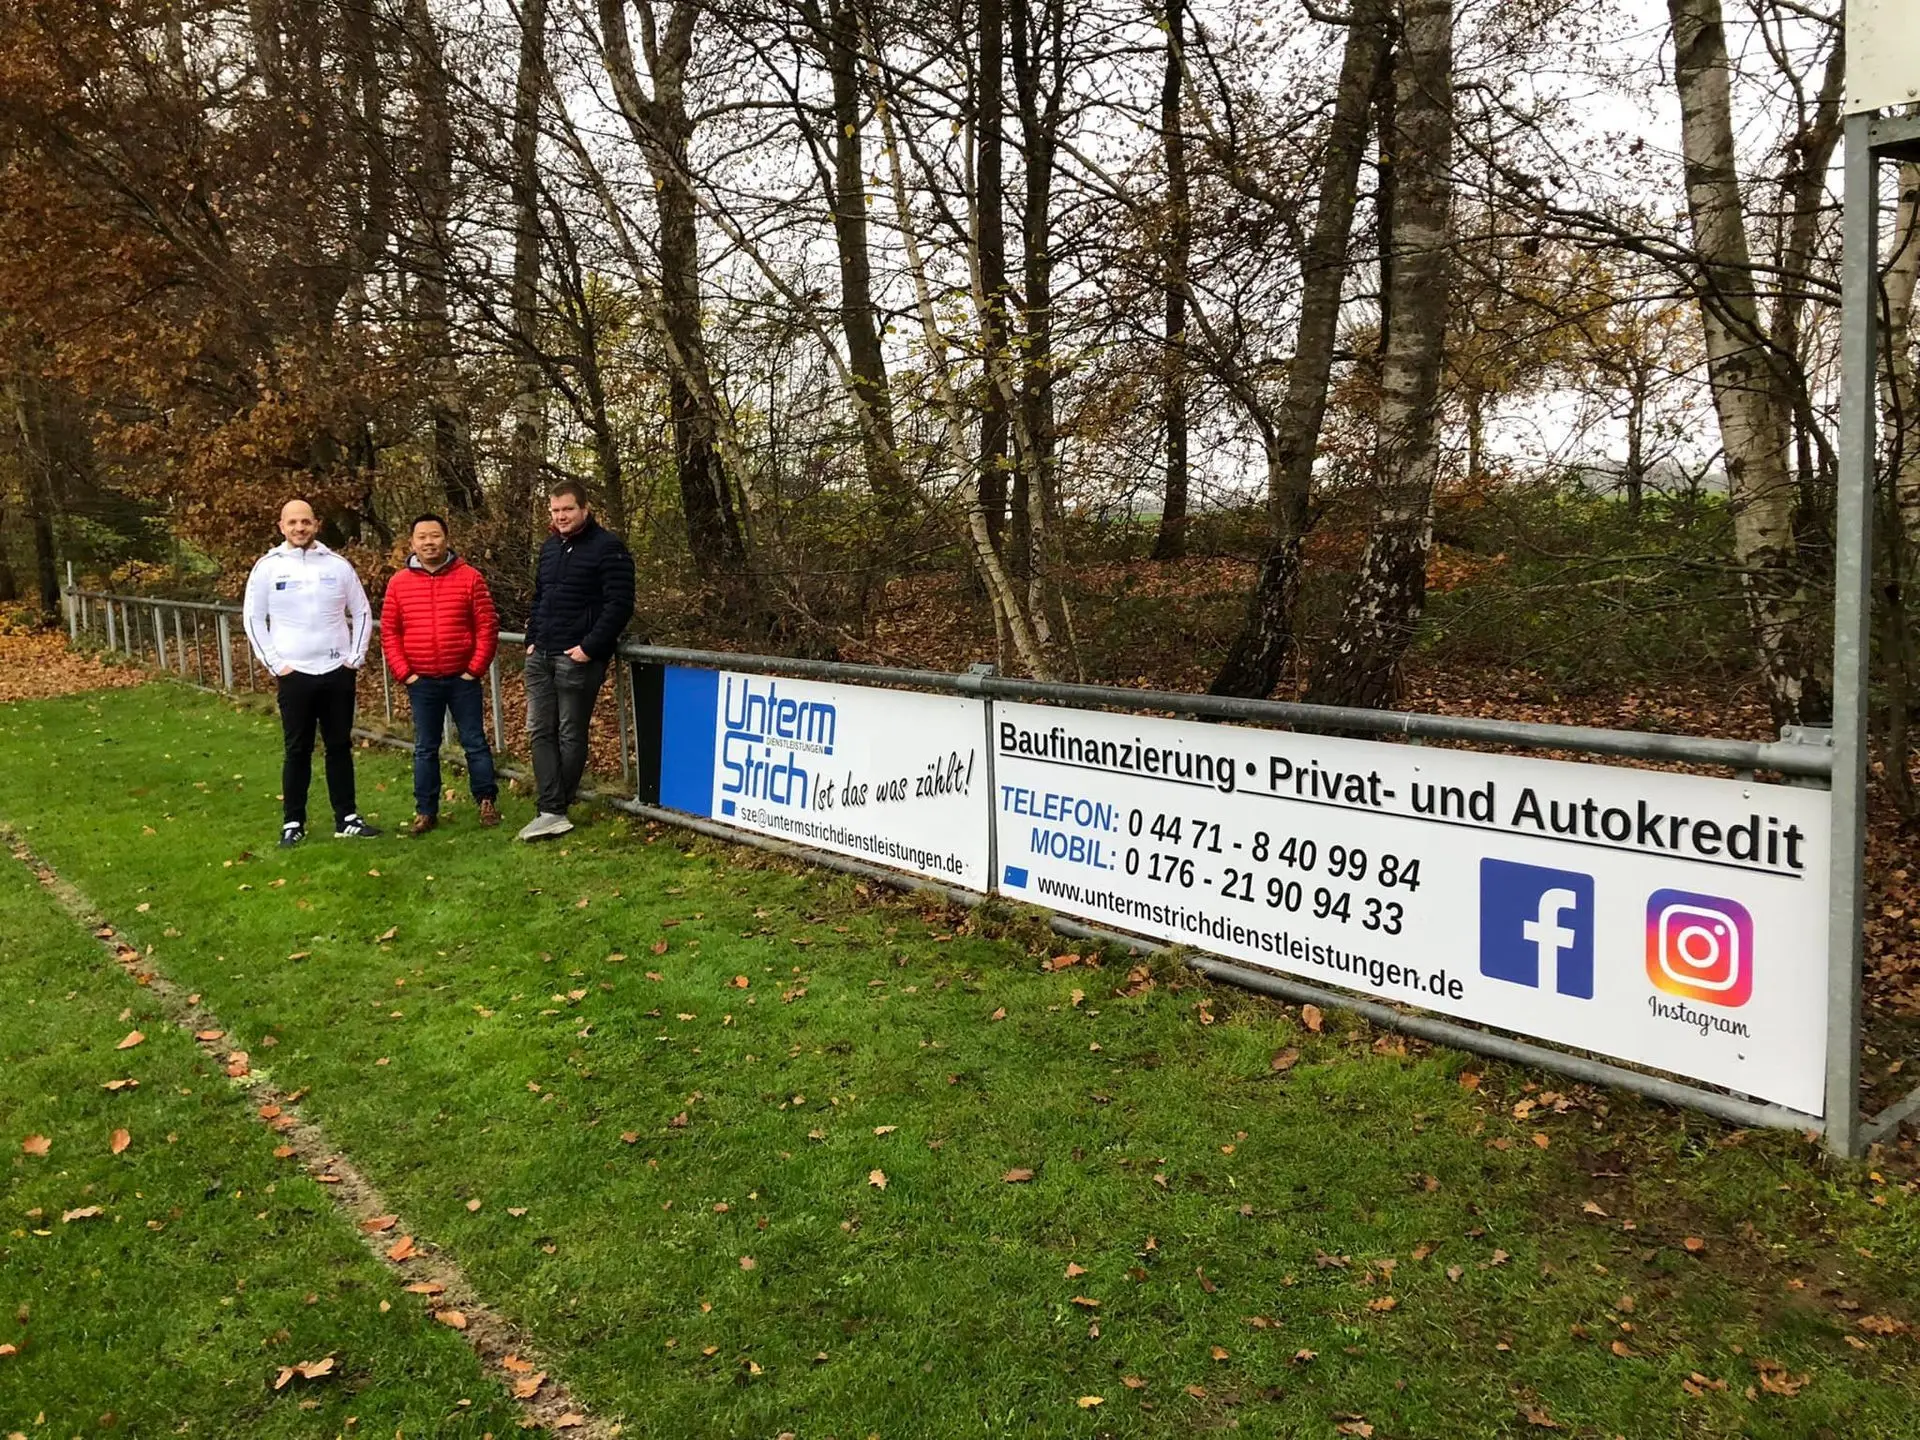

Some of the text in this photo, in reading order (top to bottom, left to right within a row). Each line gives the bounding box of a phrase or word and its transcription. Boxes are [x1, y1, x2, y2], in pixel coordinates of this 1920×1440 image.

[725, 677, 836, 745] Unterm
[766, 737, 824, 754] DIENSTLEISTUNGEN
[722, 731, 808, 809] Strich
[812, 748, 975, 811] Ist das was zählt!
[999, 721, 1236, 793] Baufinanzierung
[1269, 755, 1396, 807] Privat-
[1411, 781, 1495, 823] und
[1512, 787, 1804, 869] Autokredit
[740, 806, 963, 875] sze@untermstrichdienstleistungen.de
[1000, 785, 1120, 833] TELEFON:
[1128, 808, 1143, 837] 0
[1150, 812, 1183, 845] 44
[1191, 819, 1223, 854] 71
[1251, 831, 1270, 863] 8
[1278, 836, 1317, 872] 40
[1327, 844, 1368, 882] 99
[1378, 854, 1421, 892] 84
[1030, 827, 1116, 871] MOBIL:
[1125, 847, 1140, 875] 0
[1148, 852, 1195, 889] 176
[1221, 867, 1255, 903] 21
[1266, 876, 1302, 912] 90
[1313, 886, 1352, 925] 94
[1362, 897, 1404, 936] 33
[1037, 875, 1464, 1001] www.untermstrichdienstleistungen.de
[1648, 995, 1750, 1039] Instagram
